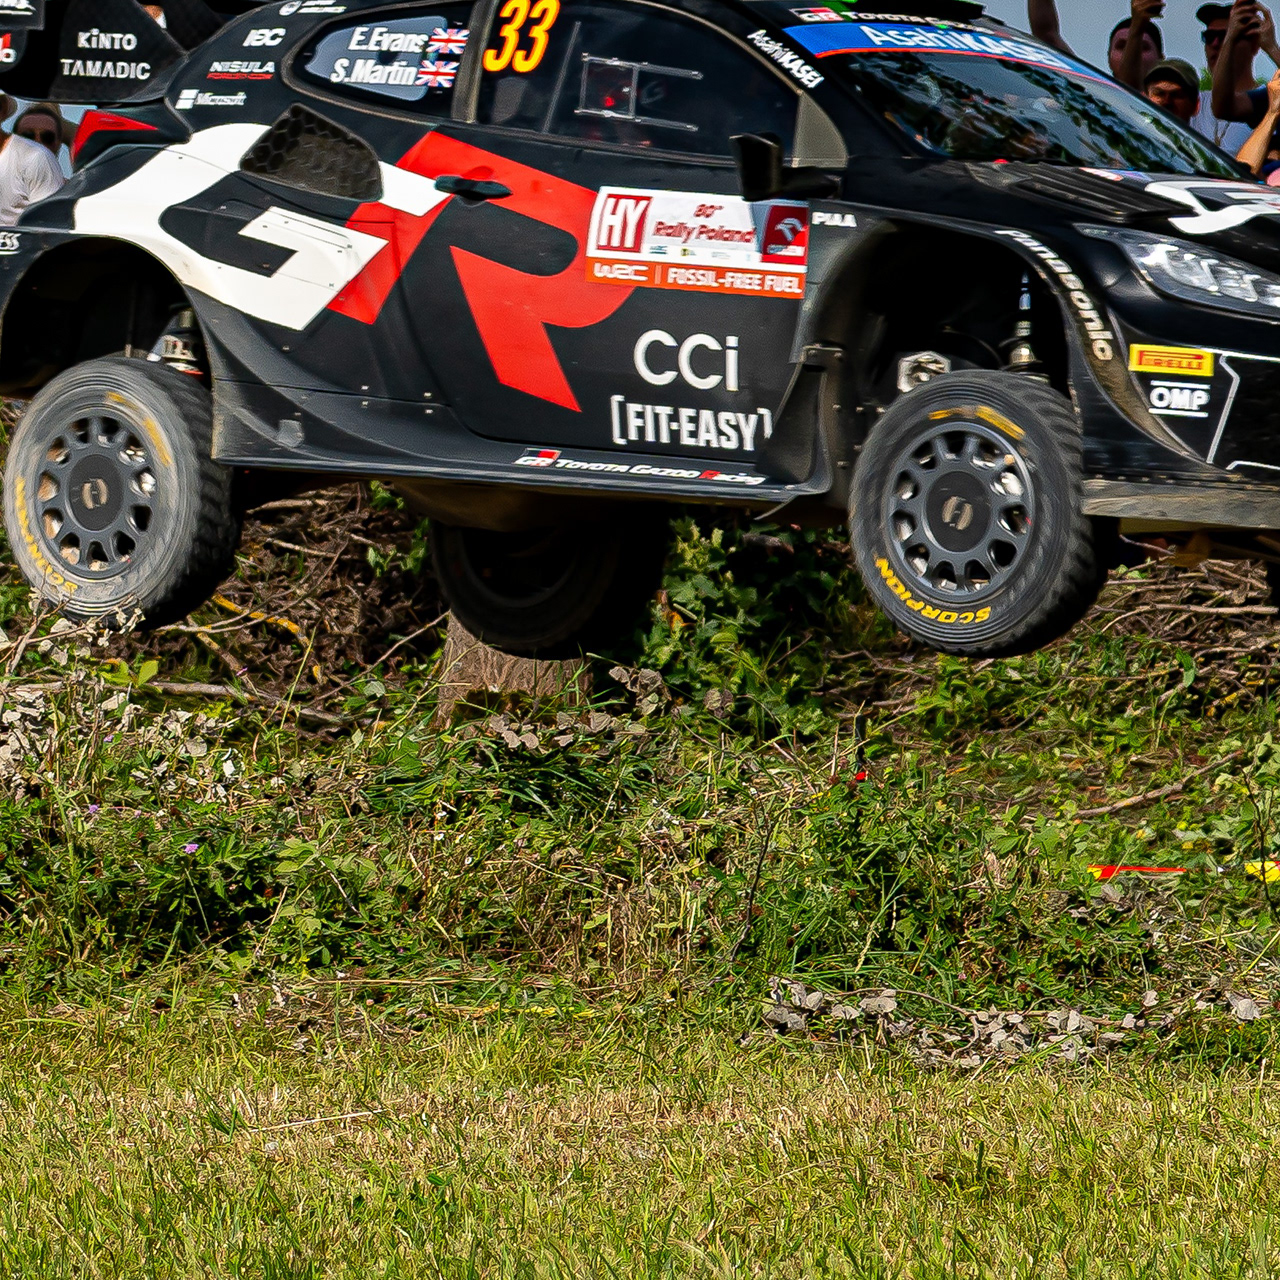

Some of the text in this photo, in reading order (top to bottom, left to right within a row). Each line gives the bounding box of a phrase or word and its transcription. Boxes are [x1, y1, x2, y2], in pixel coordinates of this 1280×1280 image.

[348, 26, 428, 53] E.Evans
[60, 58, 151, 80] TAMADIC
[330, 58, 418, 86] S.Martin
[652, 221, 757, 244] Rally Poland
[667, 267, 763, 291] FOSSIL-FREE
[763, 274, 803, 294] FUEL
[994, 229, 1114, 362] Panasonic
[633, 328, 740, 392] CCi
[1149, 386, 1211, 412] OMP
[875, 556, 992, 624] SCORPION
